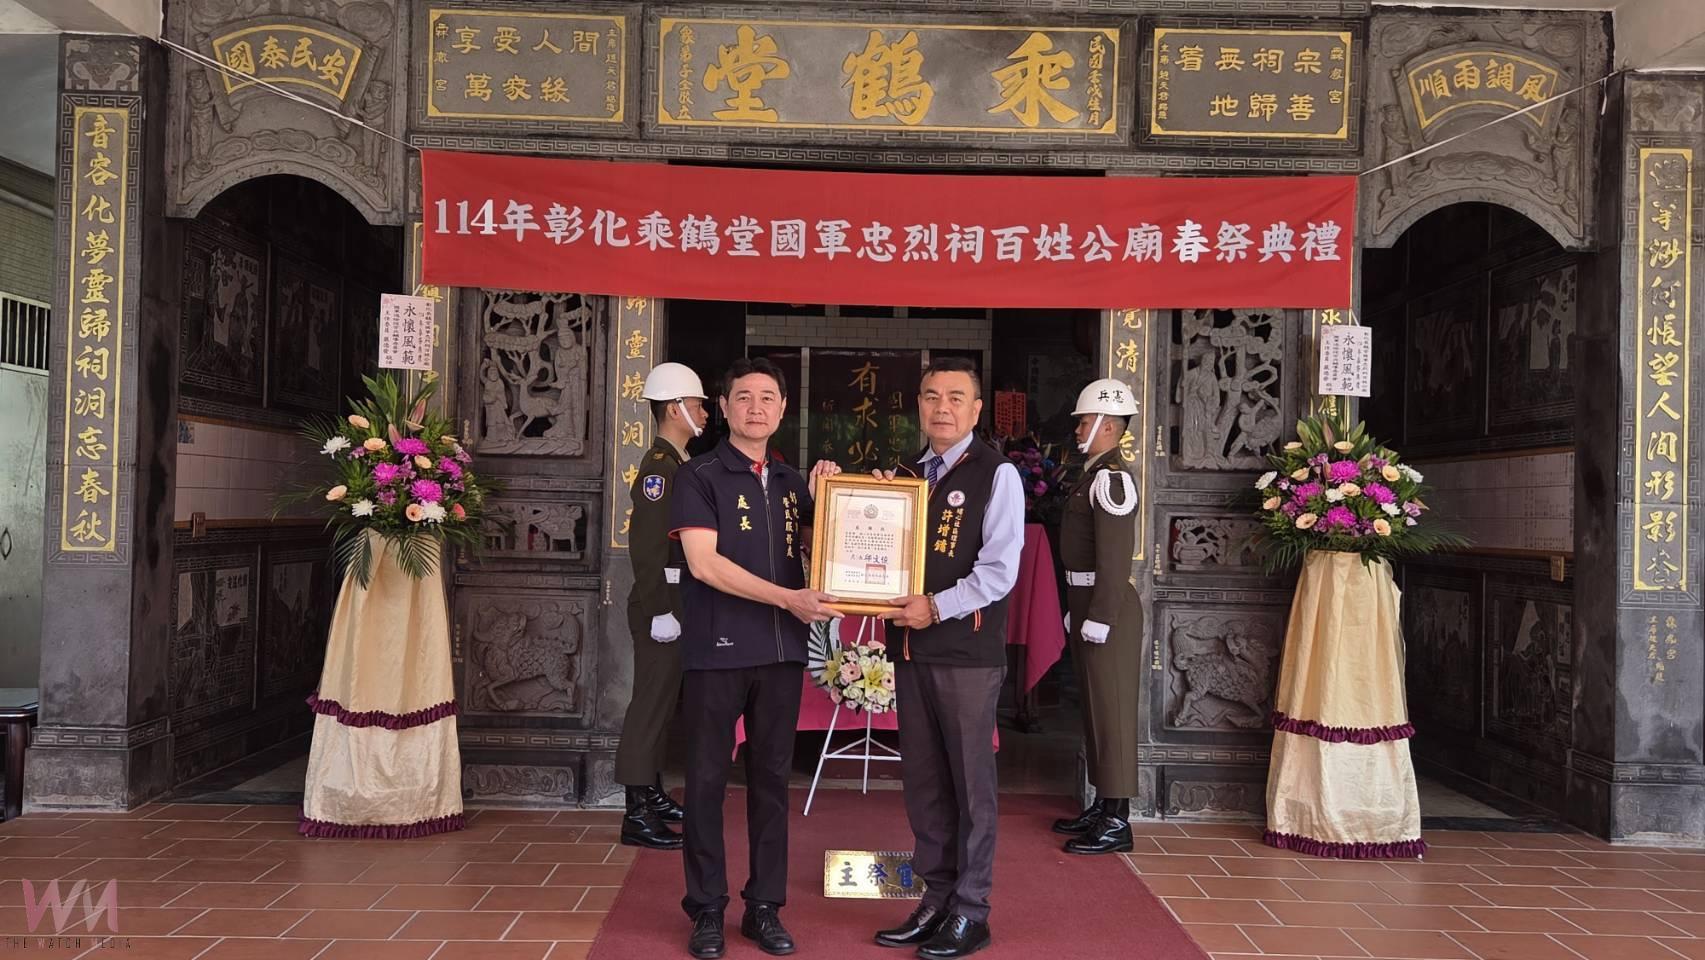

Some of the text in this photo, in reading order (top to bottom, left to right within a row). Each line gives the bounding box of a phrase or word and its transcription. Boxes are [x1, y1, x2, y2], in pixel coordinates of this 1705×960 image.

[226, 36, 346, 86] 國泰民安
[702, 25, 1080, 126] 乘鶴堂
[434, 198, 1343, 264] 114年彰化乘鶴堂國軍忠烈祠百姓公廟春祭典禮
[402, 303, 416, 364] 永懷風範
[1341, 332, 1355, 391] 永懷風範
